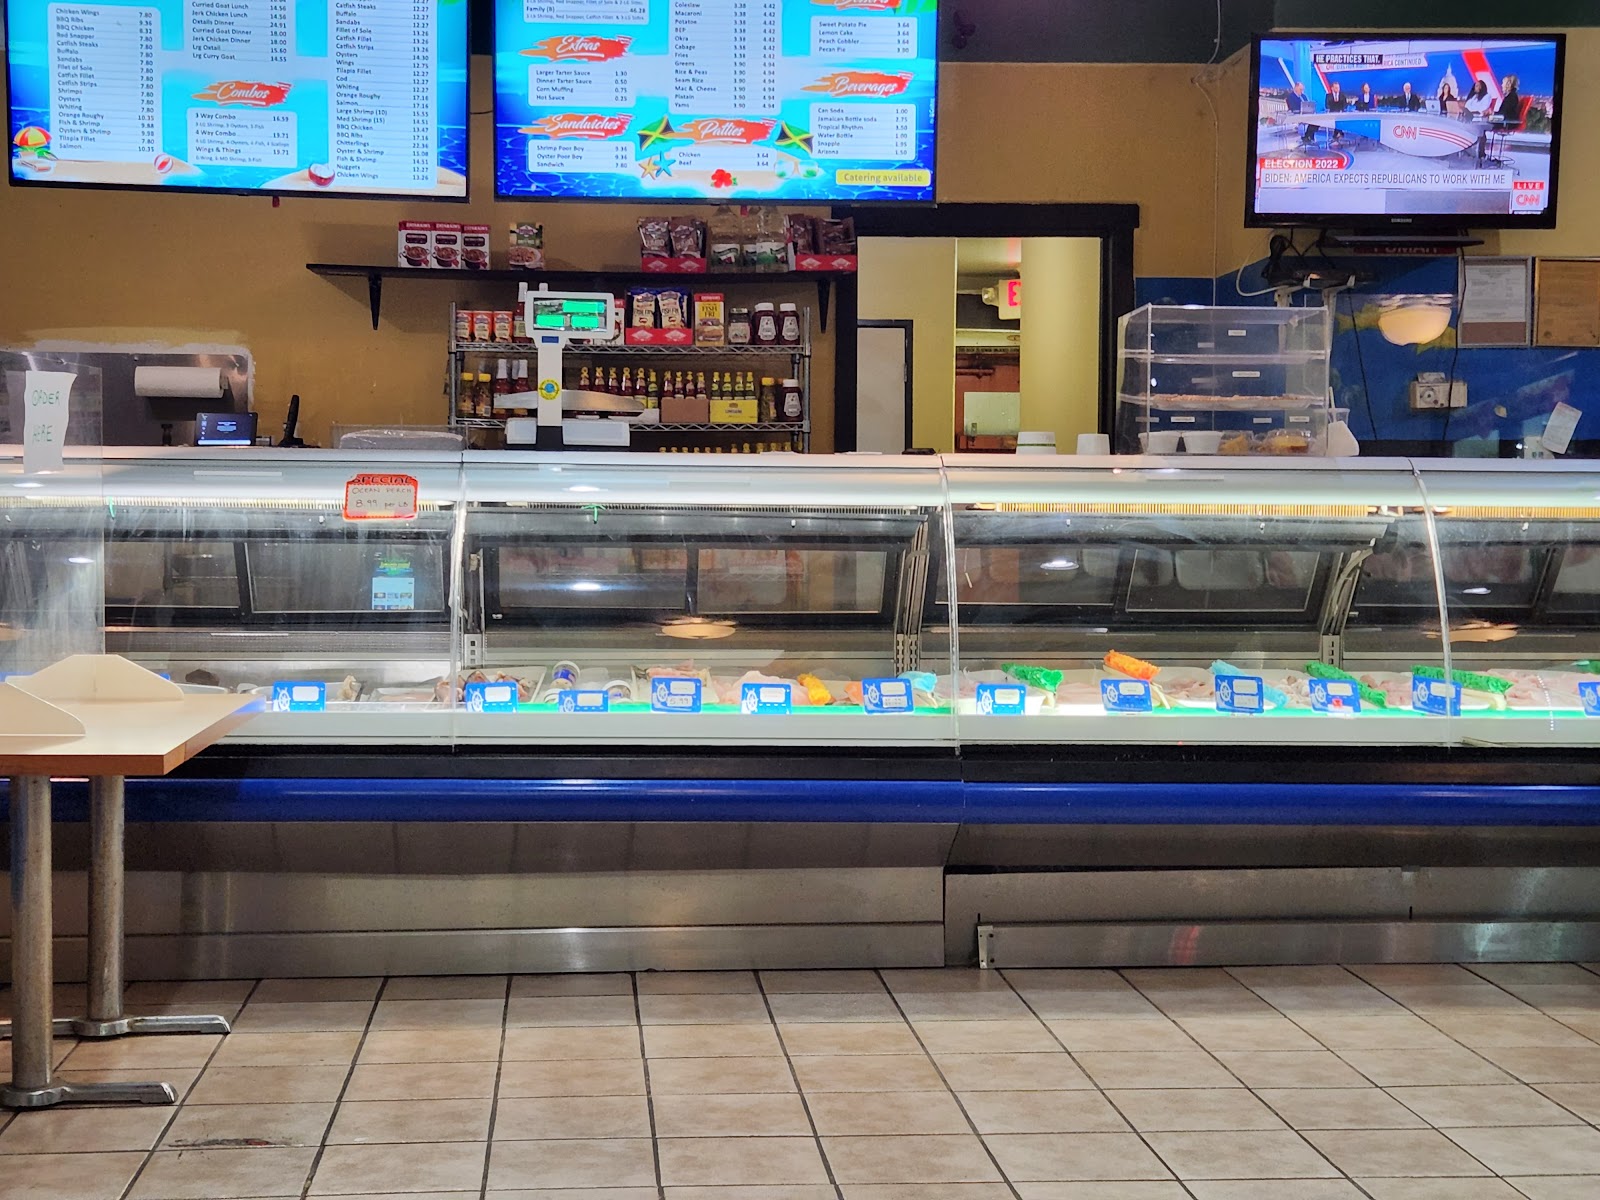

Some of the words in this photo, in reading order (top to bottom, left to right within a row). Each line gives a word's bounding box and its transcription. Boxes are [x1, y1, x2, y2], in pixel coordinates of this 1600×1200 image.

[270, 21, 286, 29] 24.91
[556, 35, 600, 53] Extras
[1316, 55, 1325, 63] HE
[1326, 54, 1362, 63] PRACTICES
[1363, 54, 1381, 63] THAT.
[1394, 58, 1421, 66] CONTINUED
[217, 82, 270, 99] Combos
[828, 76, 897, 95] Beverages
[82, 112, 104, 120] Roughy
[544, 114, 621, 132] Sandwiches
[698, 120, 745, 139] Patties
[1393, 125, 1417, 140] CNN
[1264, 159, 1313, 169] ELECTION
[1315, 160, 1338, 169] 2022
[844, 173, 881, 184] Catering
[882, 174, 922, 182] available
[1265, 173, 1292, 183] BIDEN:
[1294, 173, 1331, 183] AMERICA
[1334, 174, 1369, 184] EXPECTS
[1372, 174, 1427, 184] REPUBLICANS
[1430, 174, 1440, 184] TO
[1443, 174, 1467, 184] WORK
[1470, 174, 1490, 184] WITH
[1493, 174, 1505, 184] ME
[1516, 194, 1540, 206] CNN
[352, 475, 412, 484] SPECIAL
